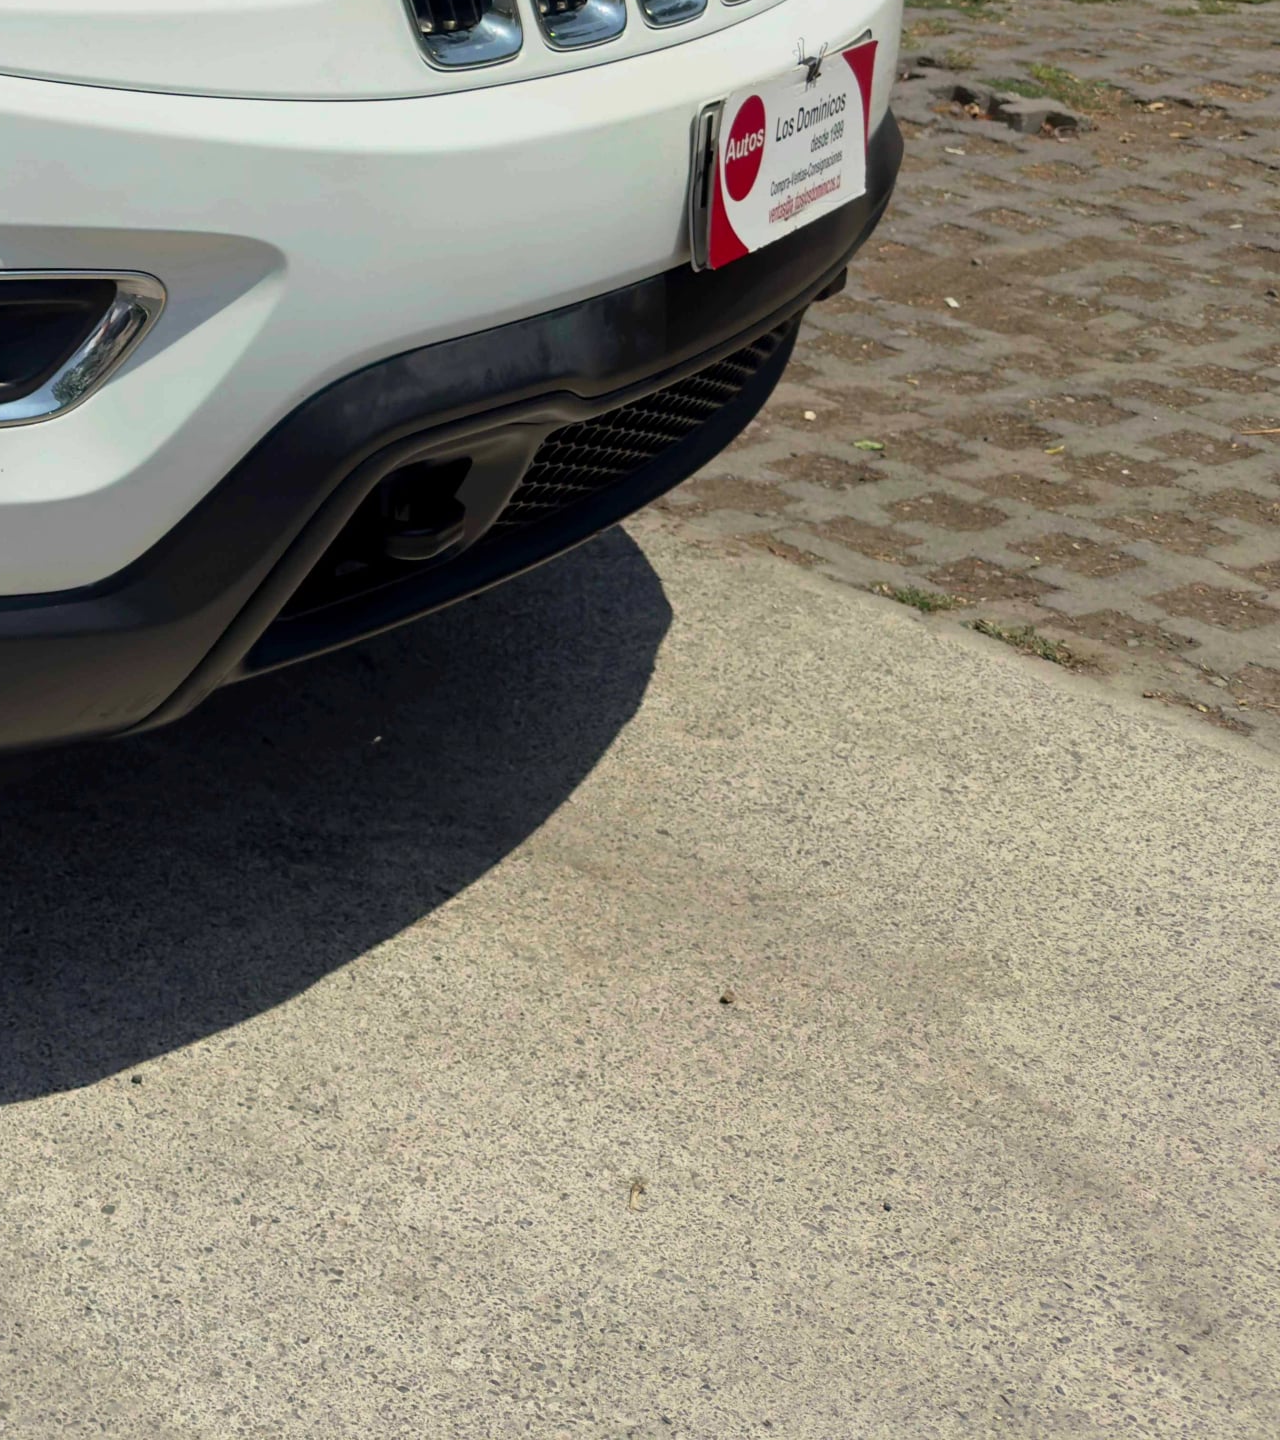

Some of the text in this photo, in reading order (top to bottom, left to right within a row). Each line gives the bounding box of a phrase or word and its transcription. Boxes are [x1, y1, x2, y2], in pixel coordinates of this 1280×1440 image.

[775, 92, 846, 143] Los Dominicos
[725, 128, 765, 164] Autos
[810, 128, 829, 153] desde
